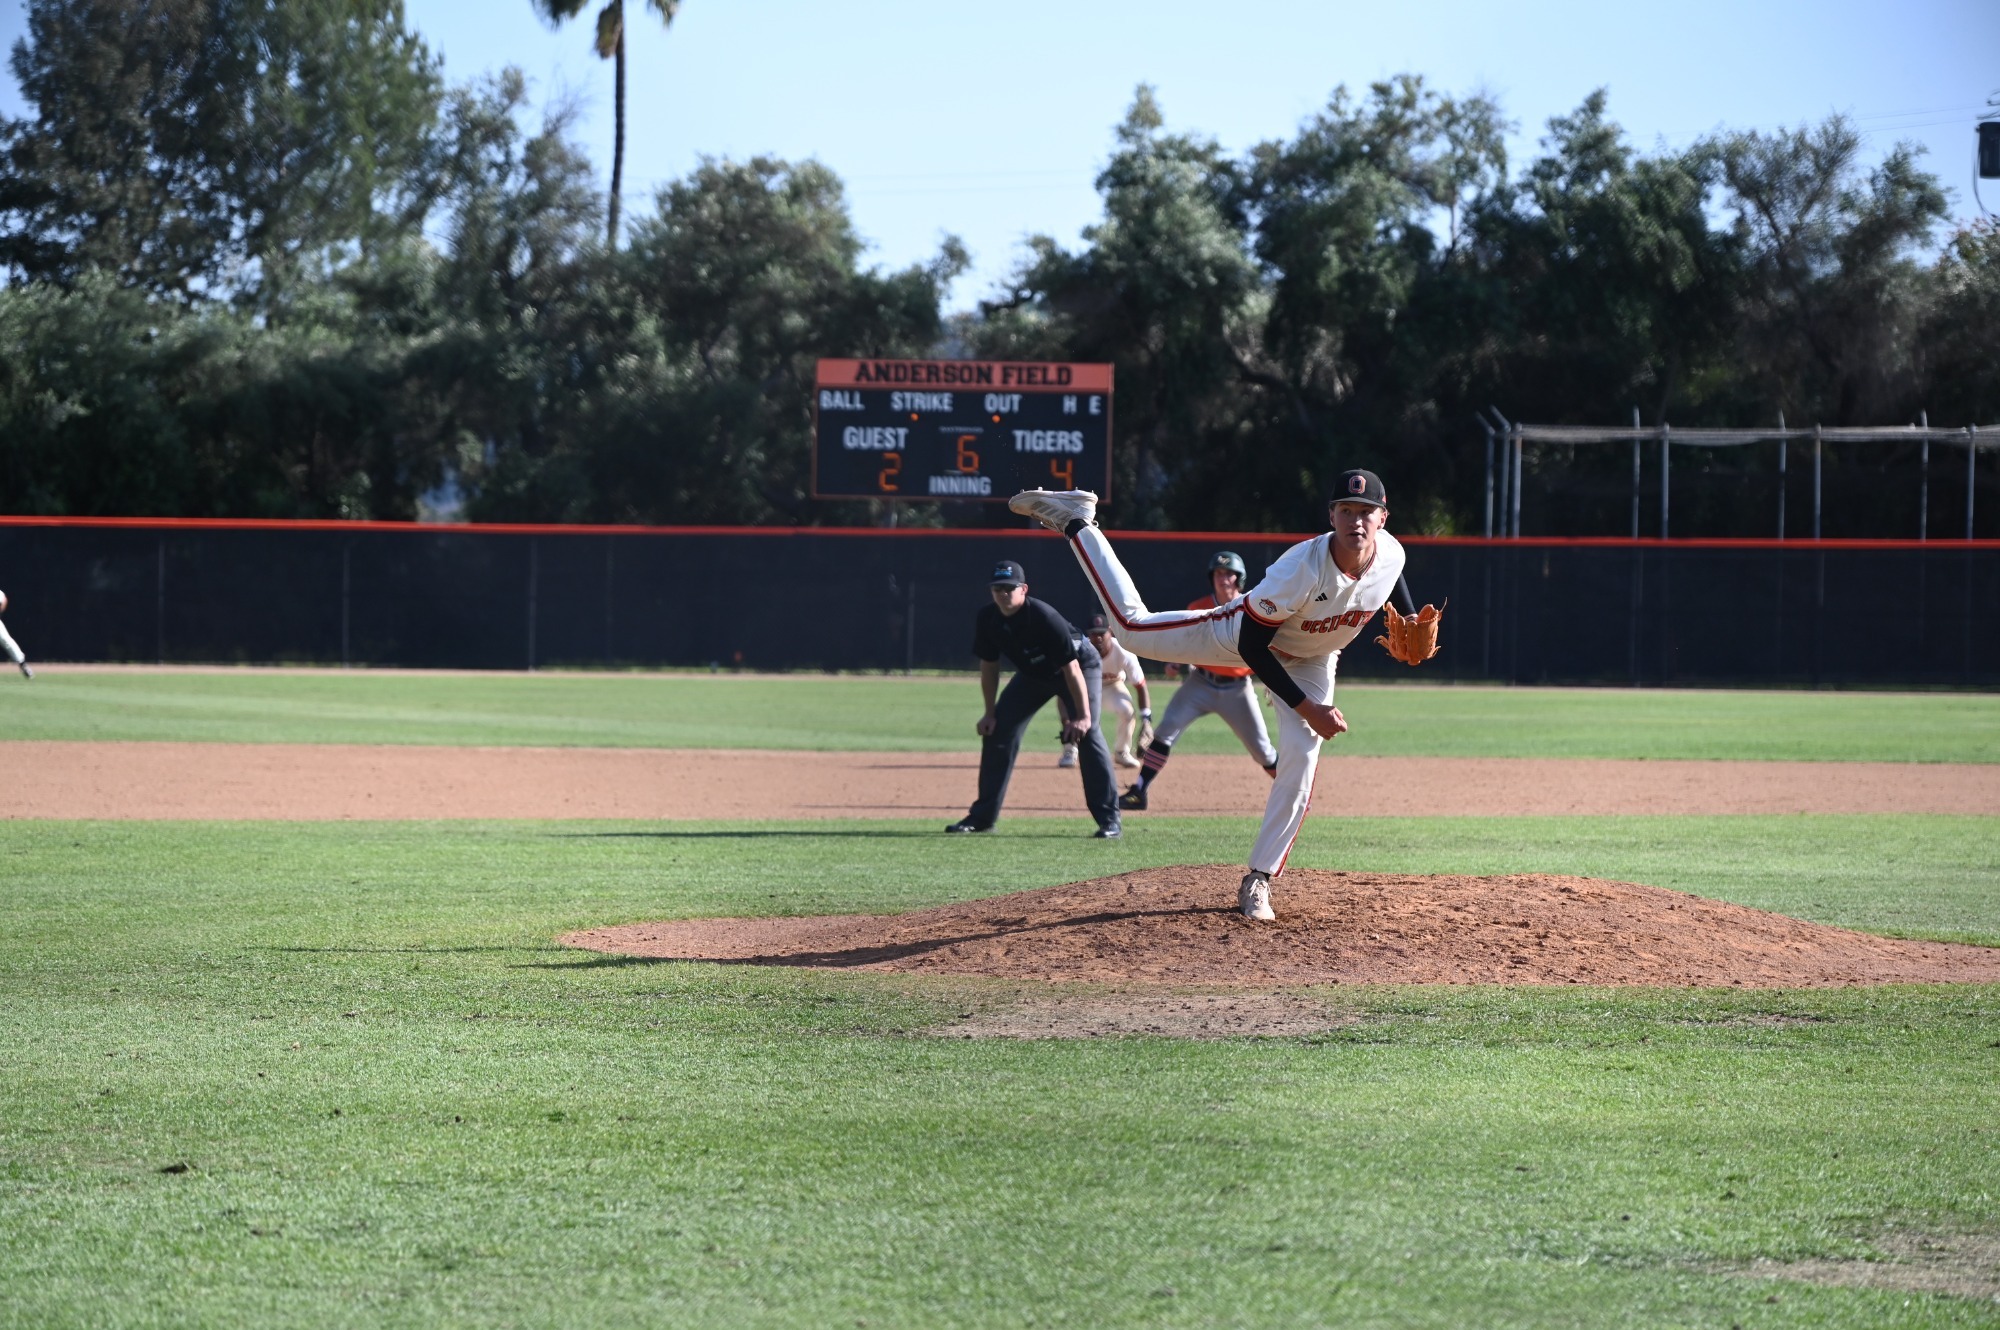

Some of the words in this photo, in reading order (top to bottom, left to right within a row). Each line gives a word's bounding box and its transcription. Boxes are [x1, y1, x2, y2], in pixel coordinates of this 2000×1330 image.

[855, 363, 993, 385] ANDERSON
[1001, 366, 1073, 386] FIELD
[820, 391, 865, 411] BALL
[891, 391, 954, 412] STRIKE
[984, 393, 1022, 414] OUT
[1063, 395, 1077, 414] H
[1089, 396, 1101, 415] E
[843, 427, 908, 449] GUEST
[1012, 429, 1084, 453] TIGERS
[957, 435, 980, 473] 6
[879, 452, 901, 491] 2
[1051, 458, 1073, 490] 4
[929, 475, 992, 496] INNING
